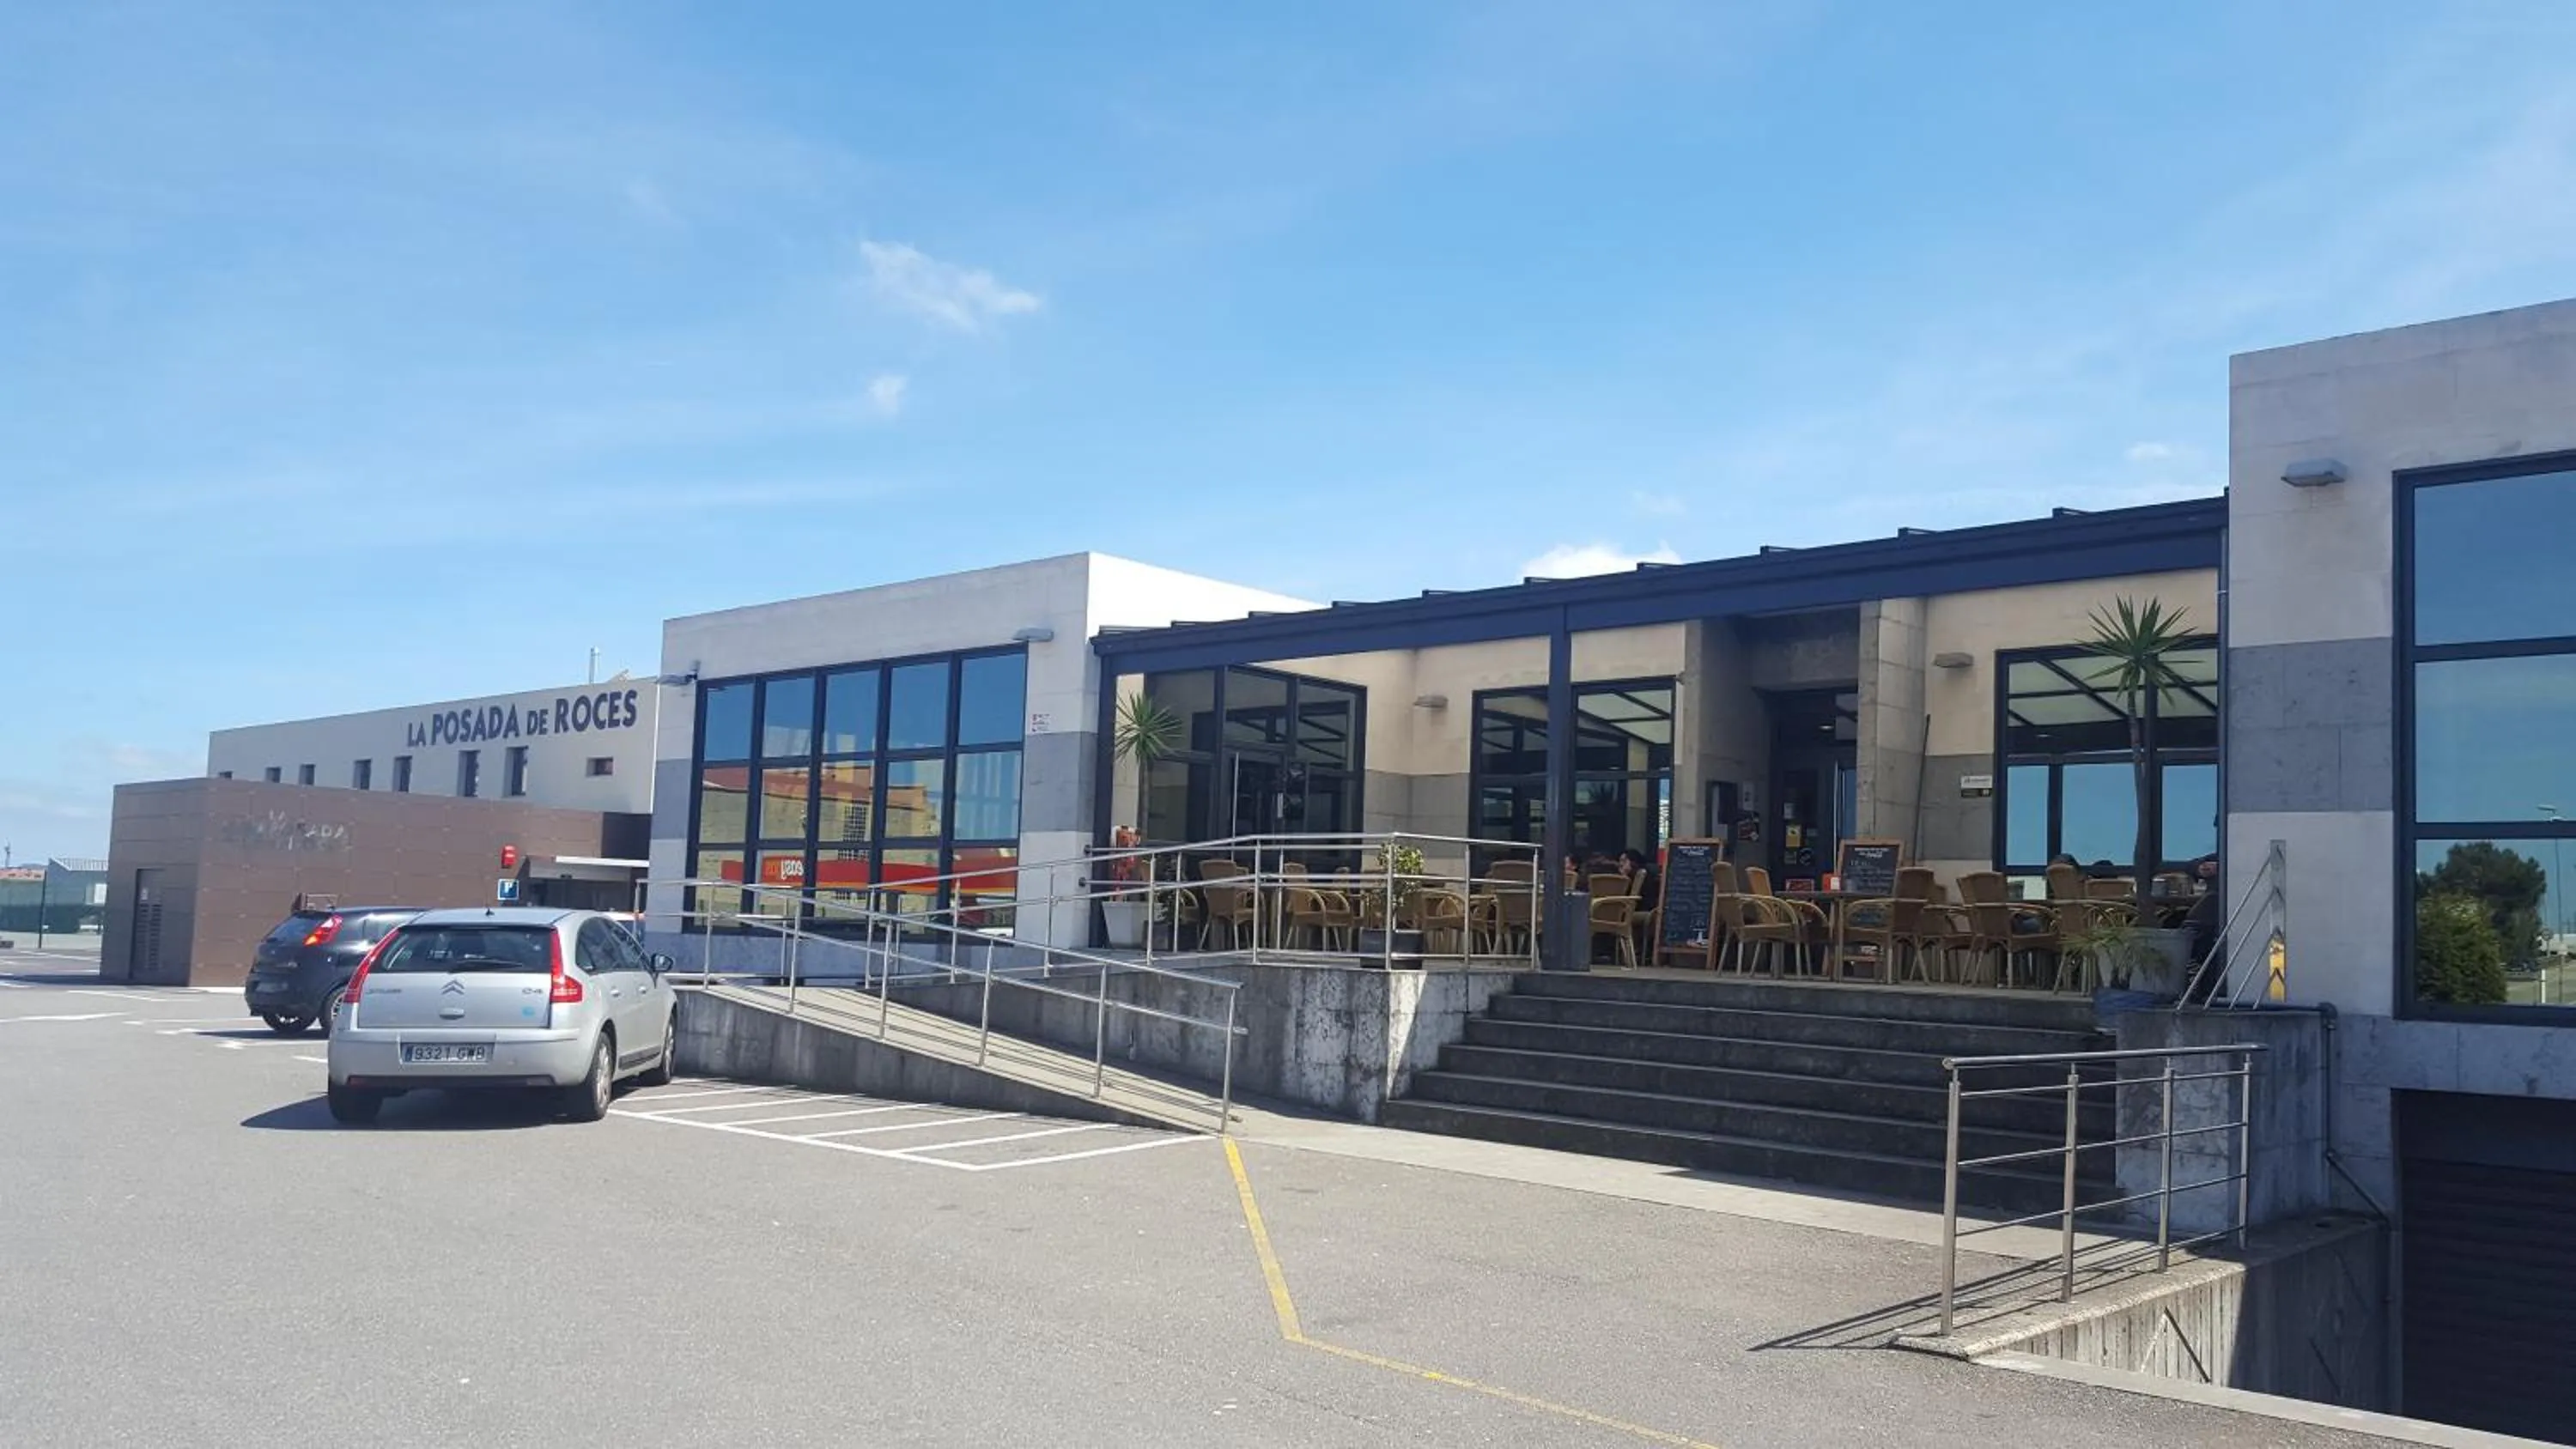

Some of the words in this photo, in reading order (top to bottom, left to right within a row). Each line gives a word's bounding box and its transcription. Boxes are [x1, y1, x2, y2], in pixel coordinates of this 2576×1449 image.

[407, 722, 427, 747] LA
[431, 703, 519, 746] POSADA
[526, 708, 548, 736] DE
[554, 689, 638, 734] ROCES
[504, 882, 513, 894] P
